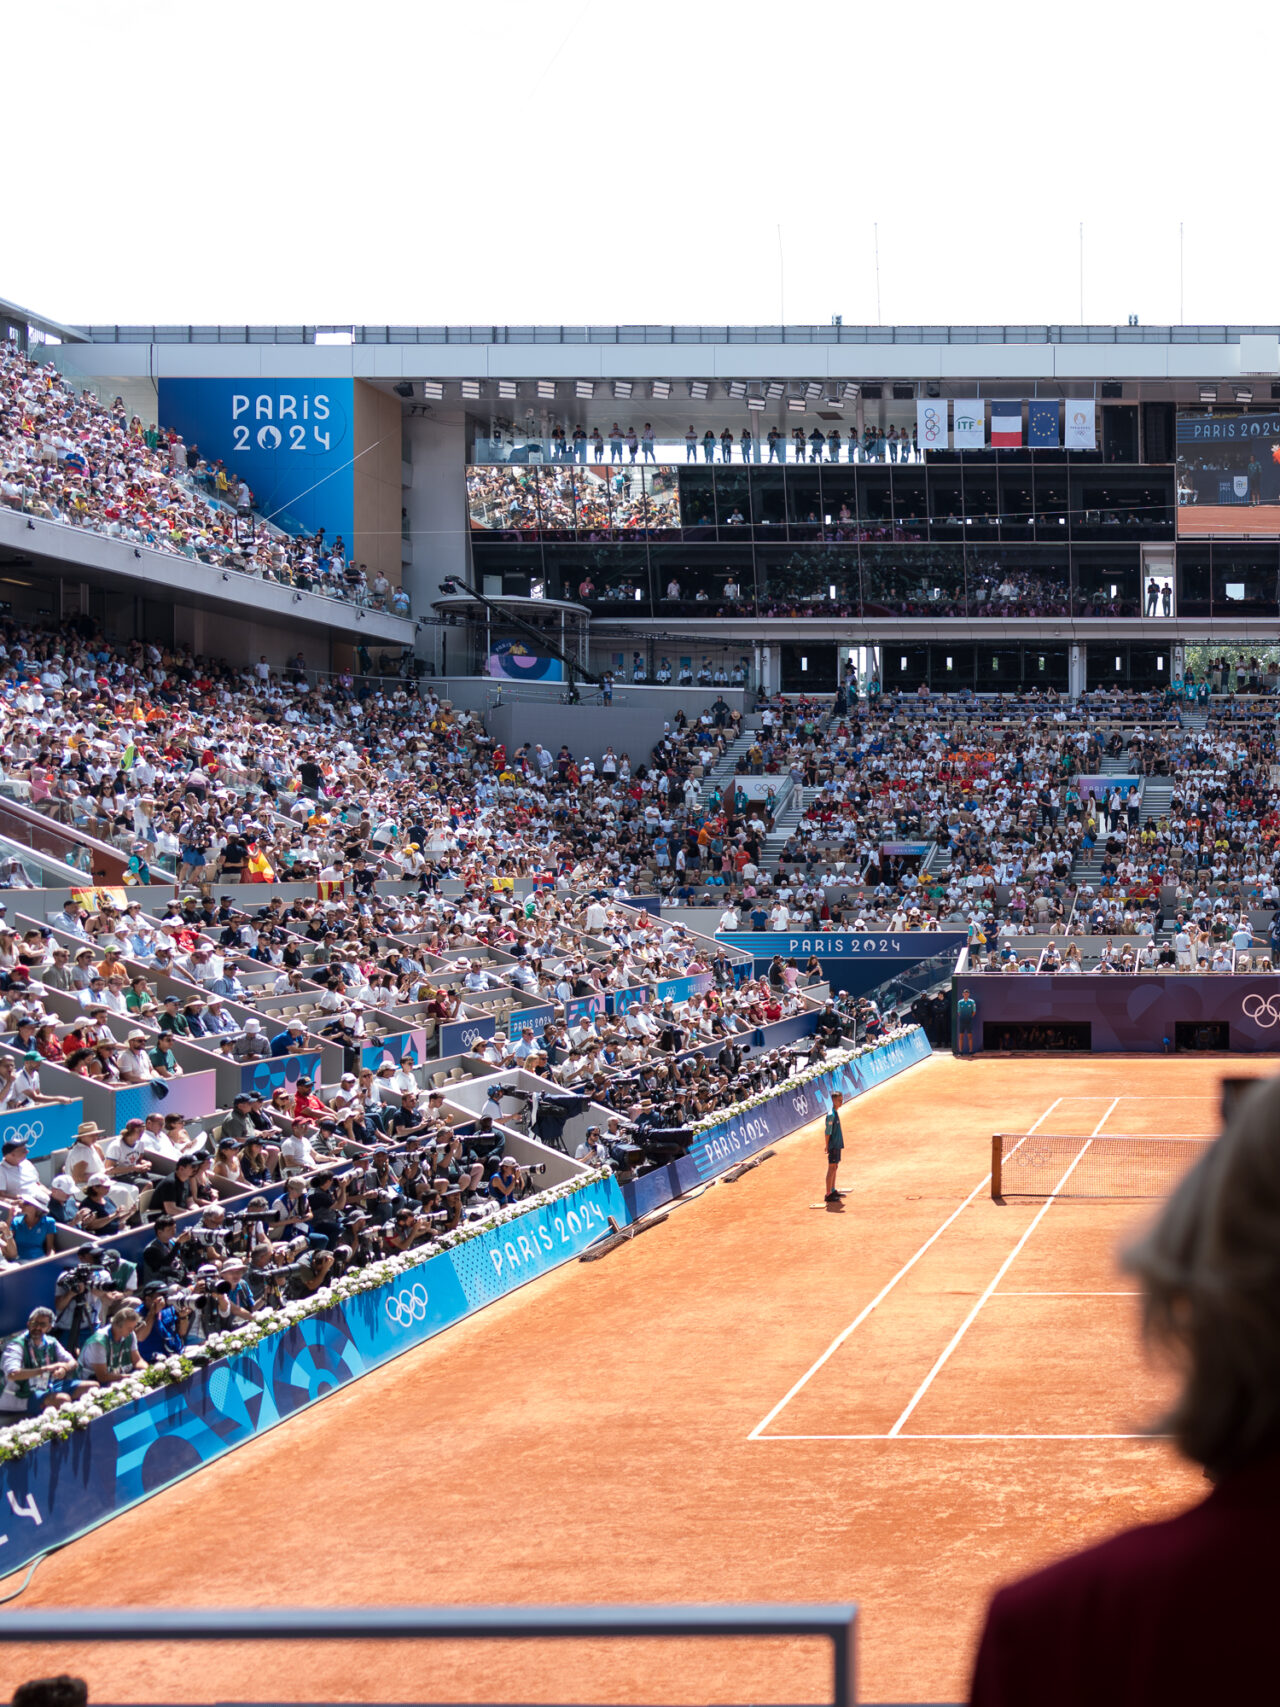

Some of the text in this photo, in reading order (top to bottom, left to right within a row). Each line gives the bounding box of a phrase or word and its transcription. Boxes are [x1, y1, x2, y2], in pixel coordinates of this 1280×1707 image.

[958, 421, 975, 430] ITF
[1241, 422, 1280, 437] 2024
[233, 425, 330, 450] 2024
[851, 939, 900, 952] 2024
[740, 1117, 770, 1145] 2024
[554, 1200, 605, 1243] 2024
